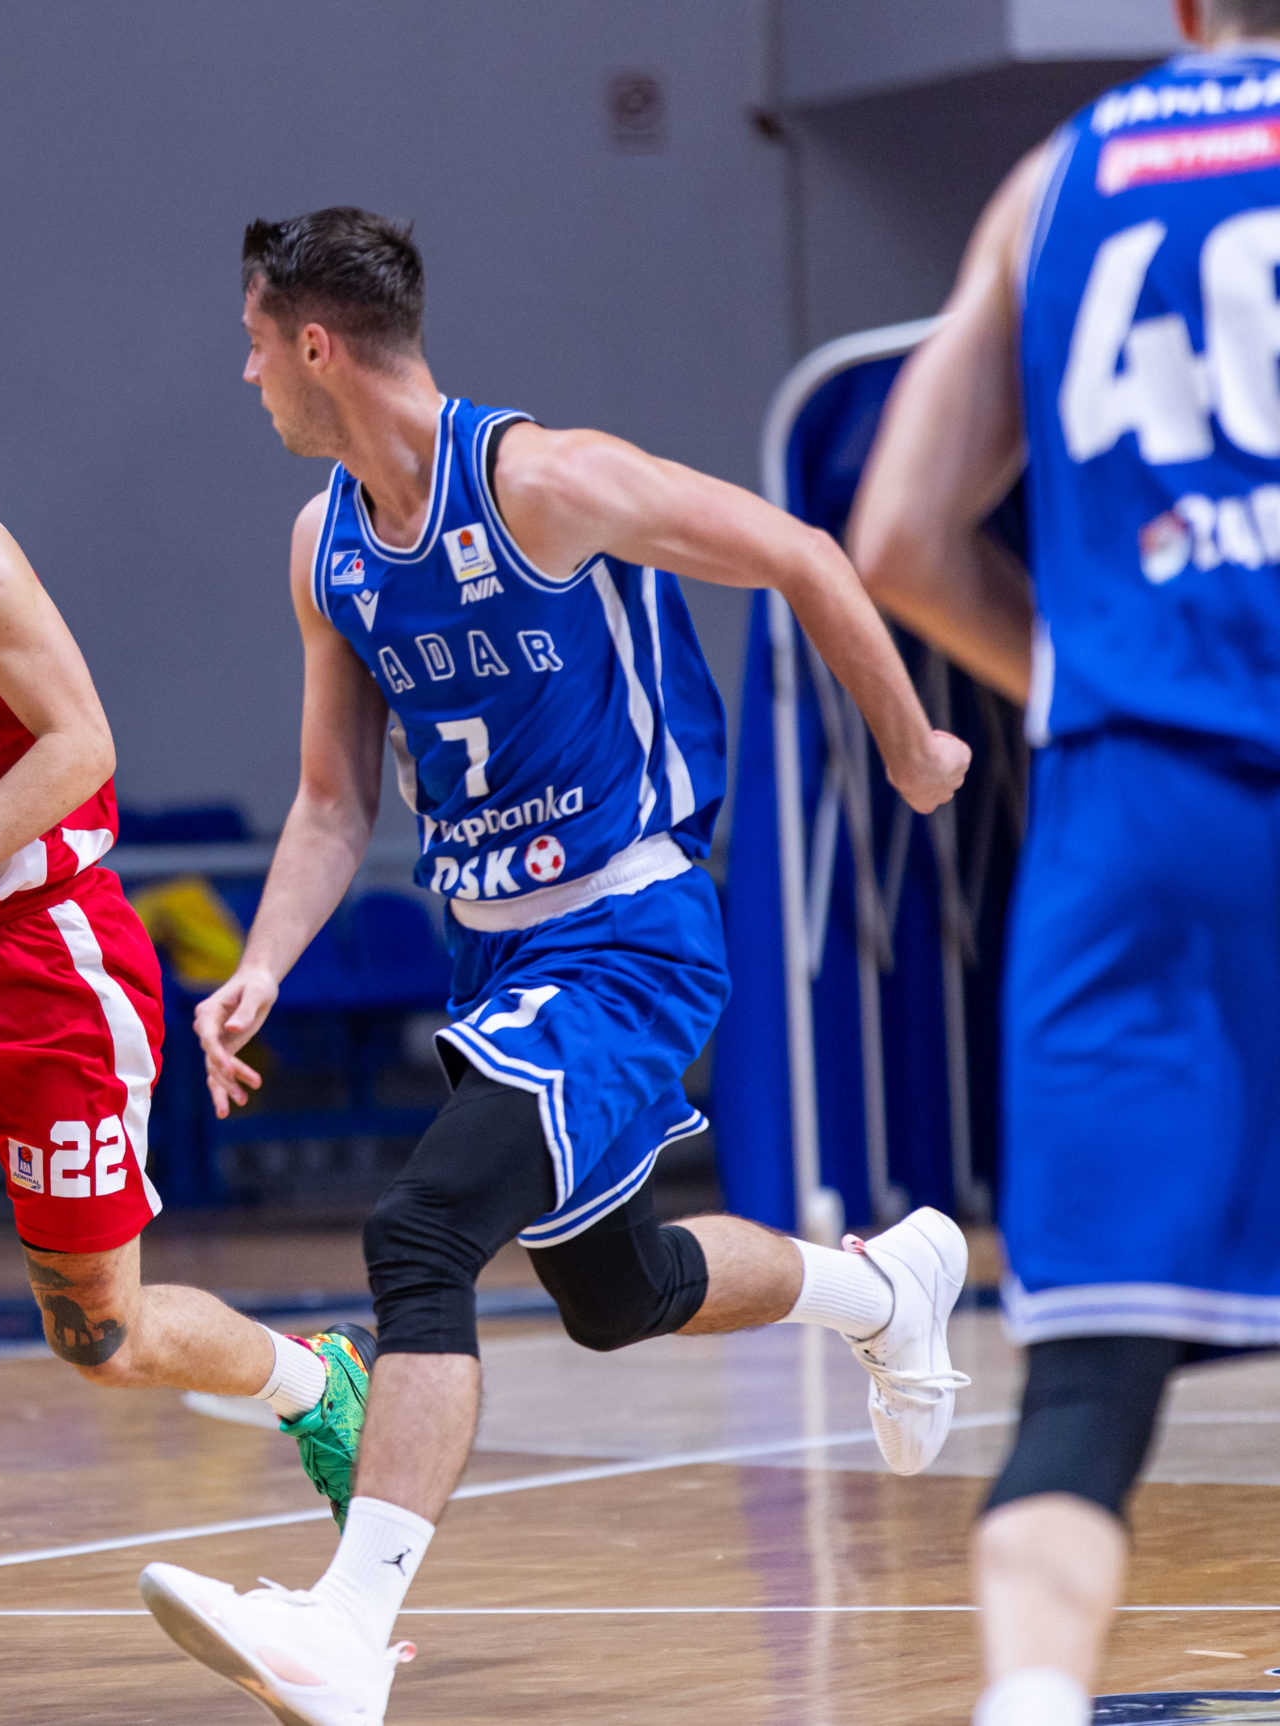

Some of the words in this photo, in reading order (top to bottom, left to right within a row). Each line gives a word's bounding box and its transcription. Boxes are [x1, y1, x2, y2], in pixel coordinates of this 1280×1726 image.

[371, 630, 564, 694] ADAR
[435, 717, 490, 798] 7
[49, 1114, 127, 1198] 22
